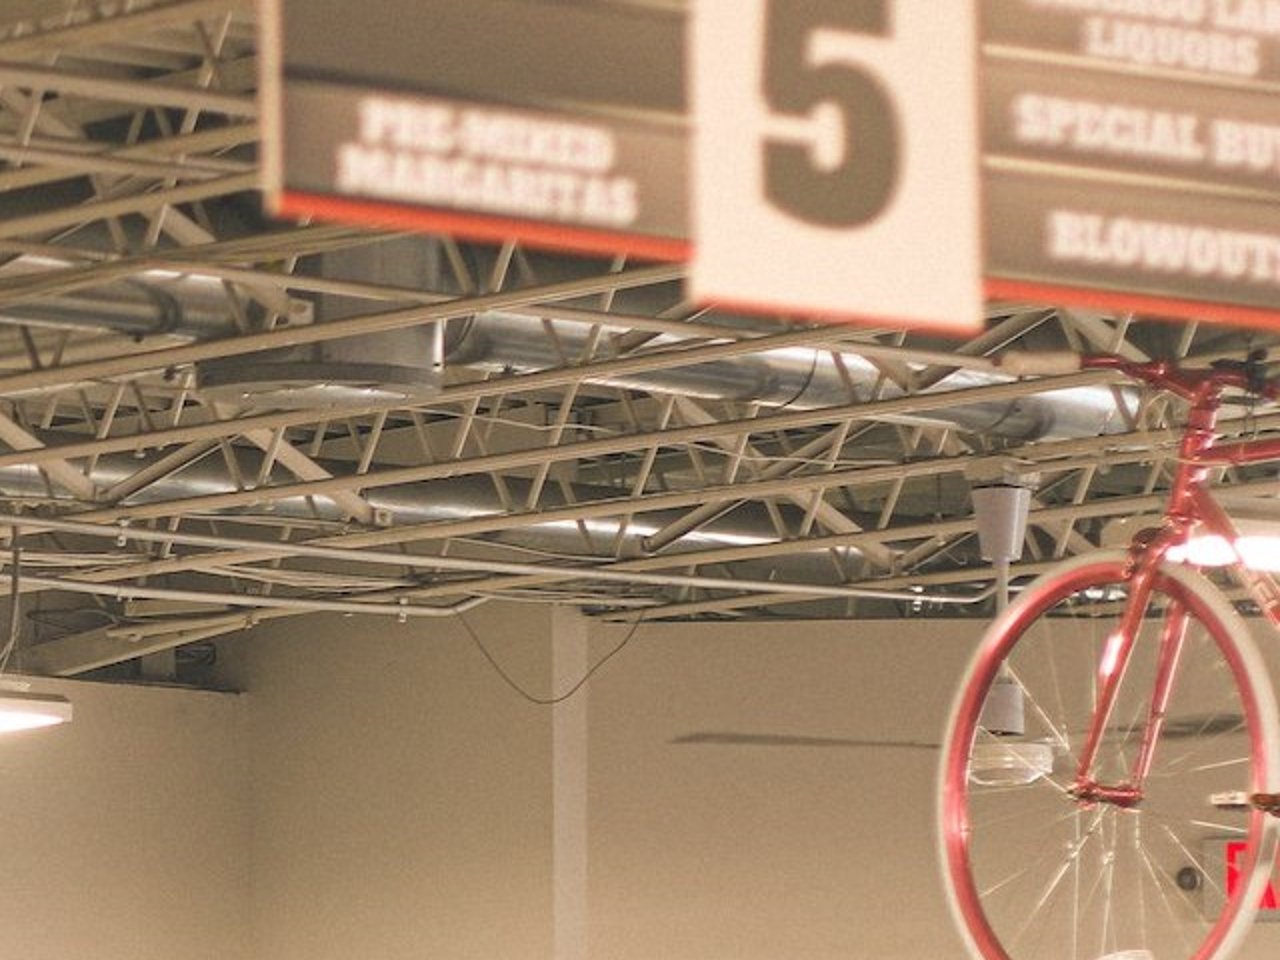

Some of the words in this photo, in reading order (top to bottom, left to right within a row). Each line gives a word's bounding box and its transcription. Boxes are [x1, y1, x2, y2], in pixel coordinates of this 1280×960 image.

[1084, 17, 1260, 77] LIQUORS
[357, 96, 615, 171] PRE-MIXED
[758, 0, 904, 231] 5
[1011, 92, 1206, 160] SPECIAL
[336, 143, 640, 227] MARGARITAS
[1045, 210, 1280, 282] BLOWOUT
